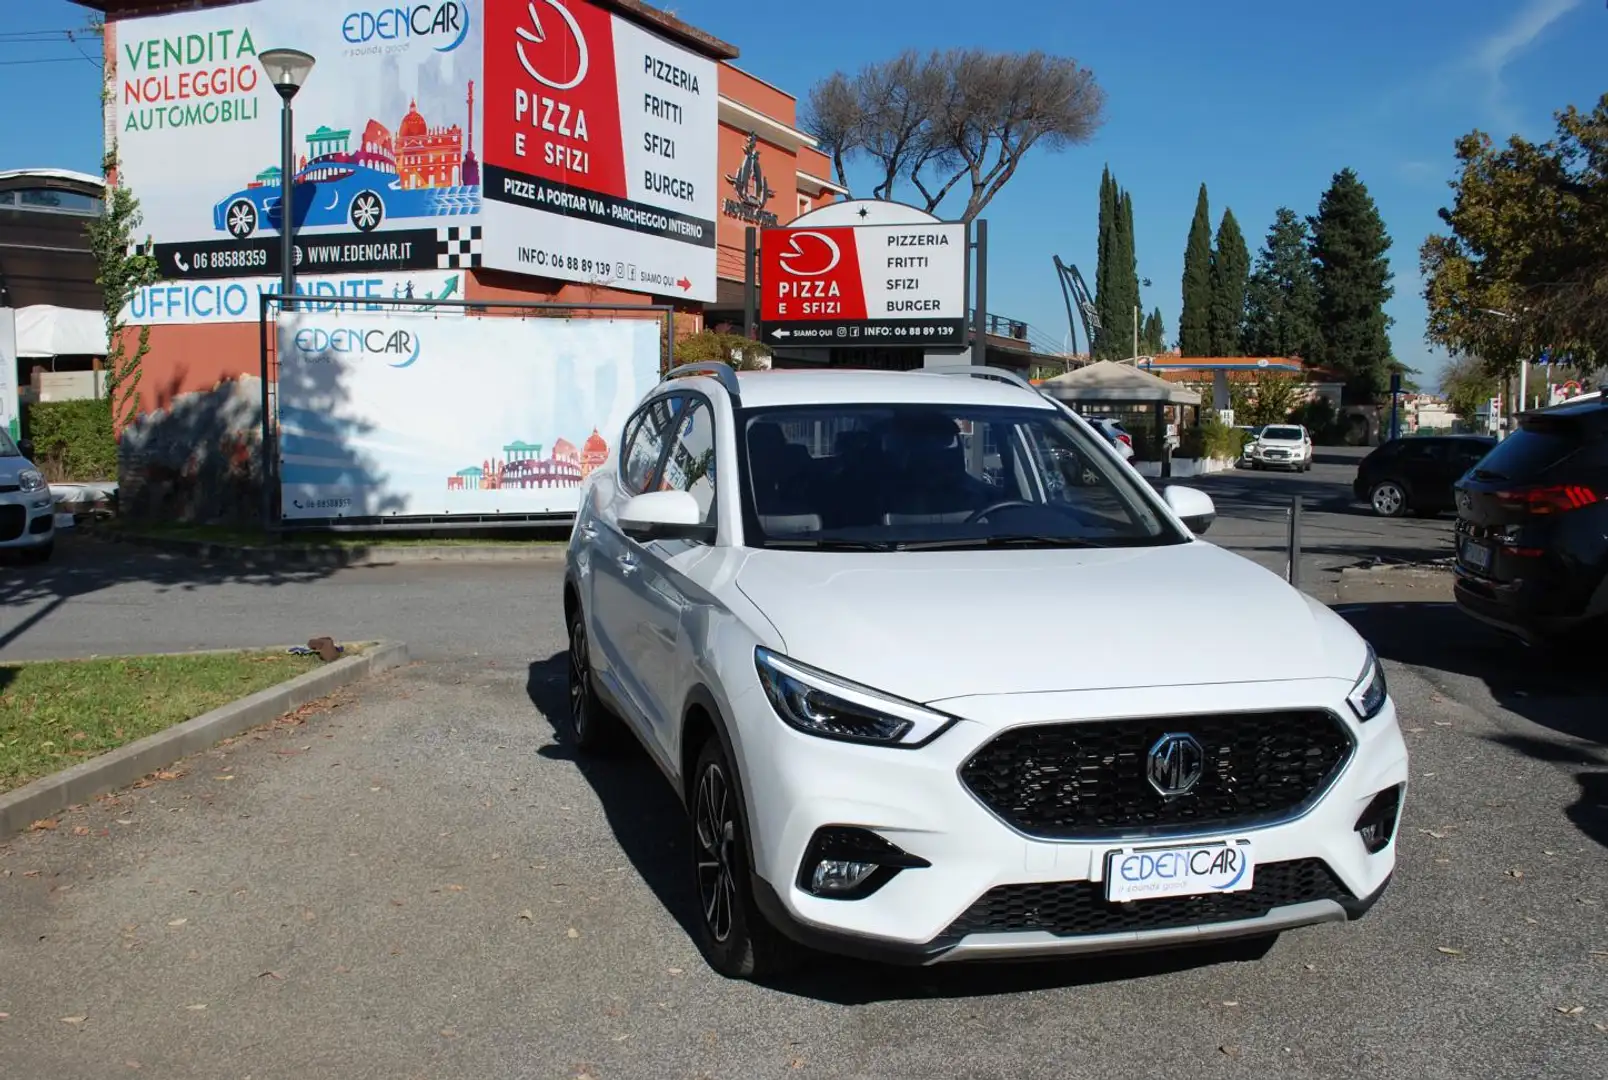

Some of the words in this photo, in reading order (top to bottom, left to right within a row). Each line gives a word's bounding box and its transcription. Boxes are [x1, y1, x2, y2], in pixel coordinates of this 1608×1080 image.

[342, 1, 460, 43] EDENCAR
[125, 27, 257, 72] VENDITA
[124, 64, 257, 105] NOLEGGIO
[644, 54, 700, 96] PIZZERIA
[124, 97, 258, 131] AUTOMOBILI
[514, 88, 589, 142] PIZZA
[644, 93, 683, 125] FRITTI
[514, 132, 526, 157] E
[544, 141, 589, 174] SFIZI
[644, 132, 675, 160] SFIZI
[644, 169, 694, 202] BURGER
[504, 177, 536, 201] PIZZE
[537, 186, 544, 202] A
[546, 190, 587, 212] PORTAR
[588, 199, 606, 217] VIA
[611, 205, 668, 231] PARCHEGGIO
[668, 221, 702, 240] INTERNO
[307, 242, 412, 264] WWW.EDENCAR.IT
[887, 234, 949, 247] PIZZERIA
[193, 252, 207, 269] 06
[210, 248, 267, 268] 88588359
[518, 246, 548, 266] INFO:
[551, 254, 564, 269] 06
[566, 257, 579, 272] 88
[581, 260, 593, 275] 89
[595, 262, 611, 277] 139
[640, 270, 661, 286] SIAMO
[887, 256, 928, 268] FRITTI
[778, 280, 841, 298] PIZZA
[886, 278, 919, 290] SFIZI
[130, 283, 248, 319] UFFICIO
[778, 303, 787, 315] E
[802, 302, 841, 314] SFIZI
[886, 300, 941, 312] BURGER
[294, 328, 412, 353] EDENCAR
[793, 329, 818, 338] SIAMO
[819, 329, 833, 338] QUI
[864, 326, 892, 337] INFO:
[894, 327, 907, 337] 06
[909, 327, 921, 337] 88
[923, 326, 935, 337] 89
[937, 325, 954, 336] 139
[1154, 739, 1202, 790] MG
[1120, 848, 1237, 881] EDENCAR
